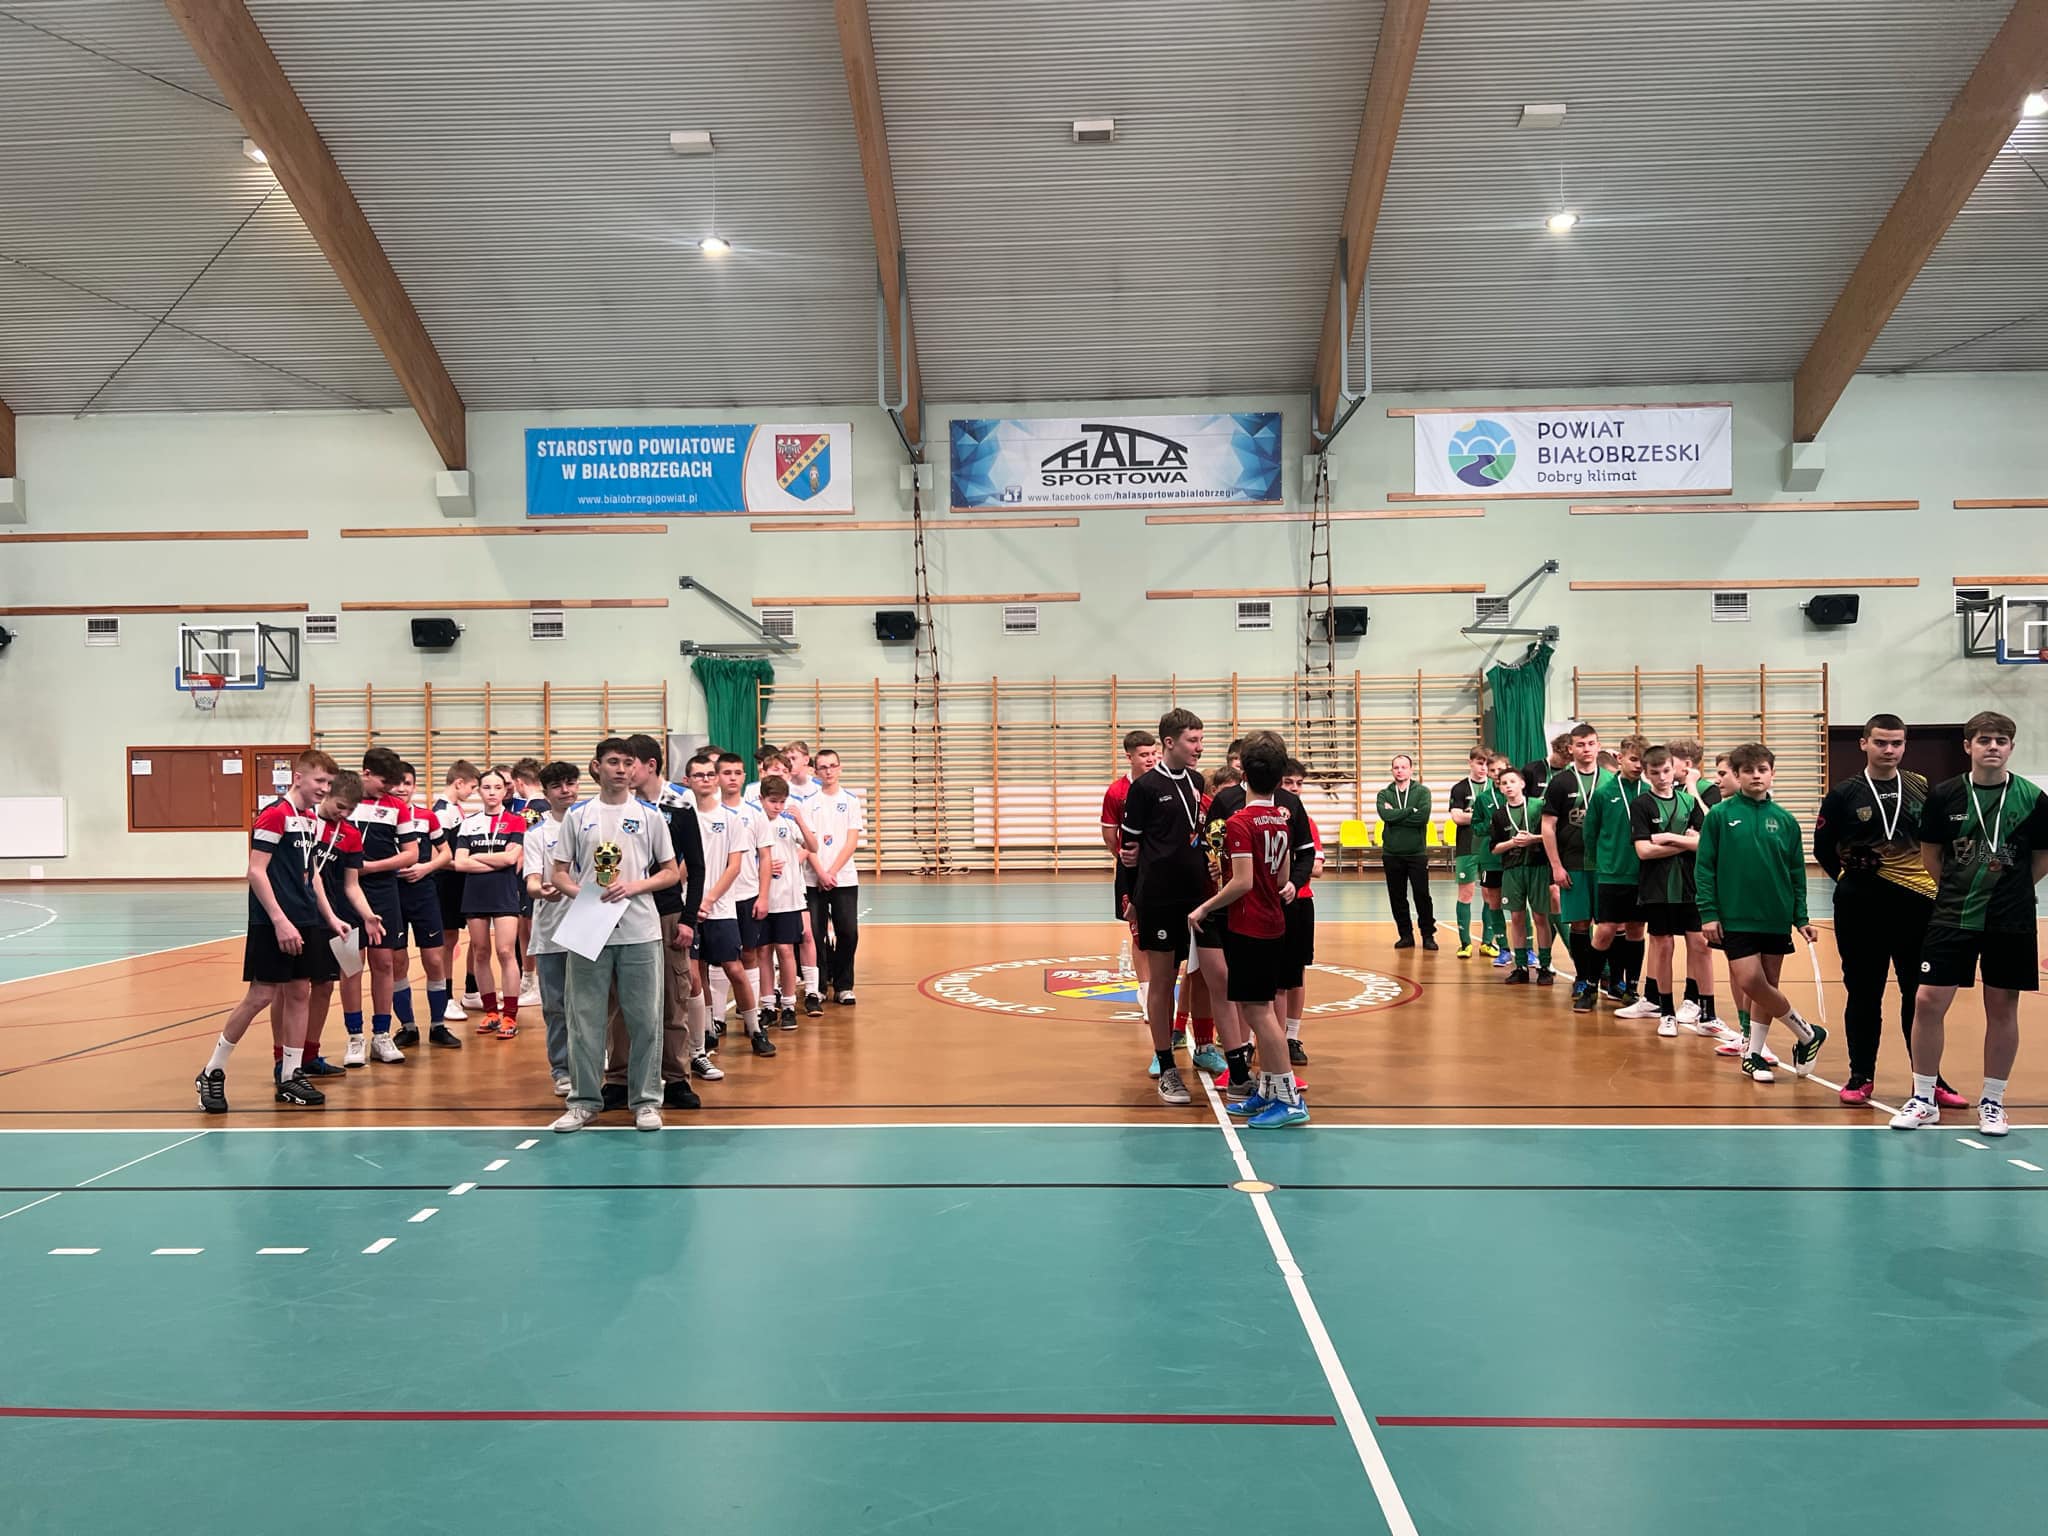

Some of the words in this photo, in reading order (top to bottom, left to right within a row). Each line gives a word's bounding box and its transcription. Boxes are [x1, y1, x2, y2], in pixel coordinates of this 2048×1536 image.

[1537, 421, 1625, 439] POWIAT
[537, 438, 633, 457] STAROSTWO
[639, 437, 735, 455] POWIATOWE
[1041, 424, 1188, 469] HALA
[1537, 444, 1700, 464] BIAŁOBRZESKI
[562, 463, 576, 480] W
[582, 461, 712, 479] BIAŁOBRZEGACH
[1041, 471, 1188, 487] SPORTOWA
[1537, 471, 1583, 485] Dobry
[1588, 469, 1637, 482] klimat
[1920, 961, 1931, 973] 9
